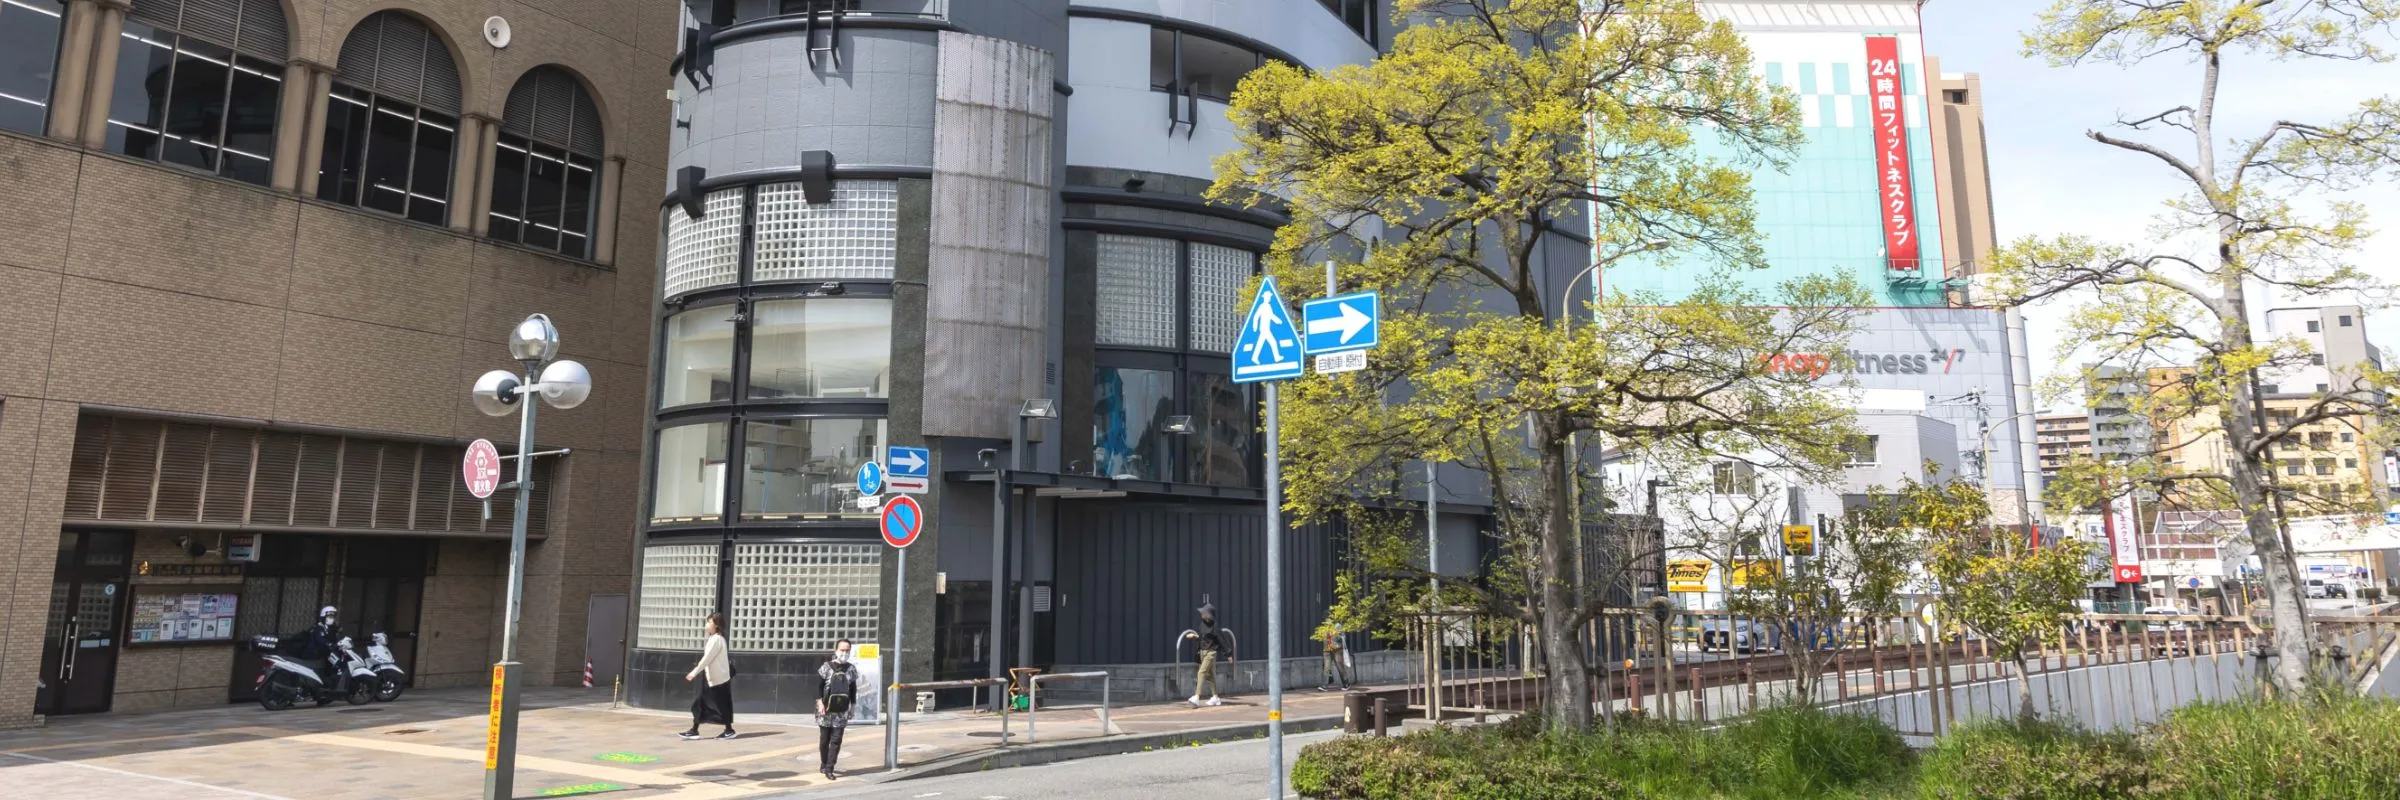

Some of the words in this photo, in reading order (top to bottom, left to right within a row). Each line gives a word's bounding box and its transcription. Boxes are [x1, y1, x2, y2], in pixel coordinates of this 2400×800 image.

[1871, 59, 1909, 246] 24時間フィットネスクラブ
[1670, 565, 1703, 578] Times
